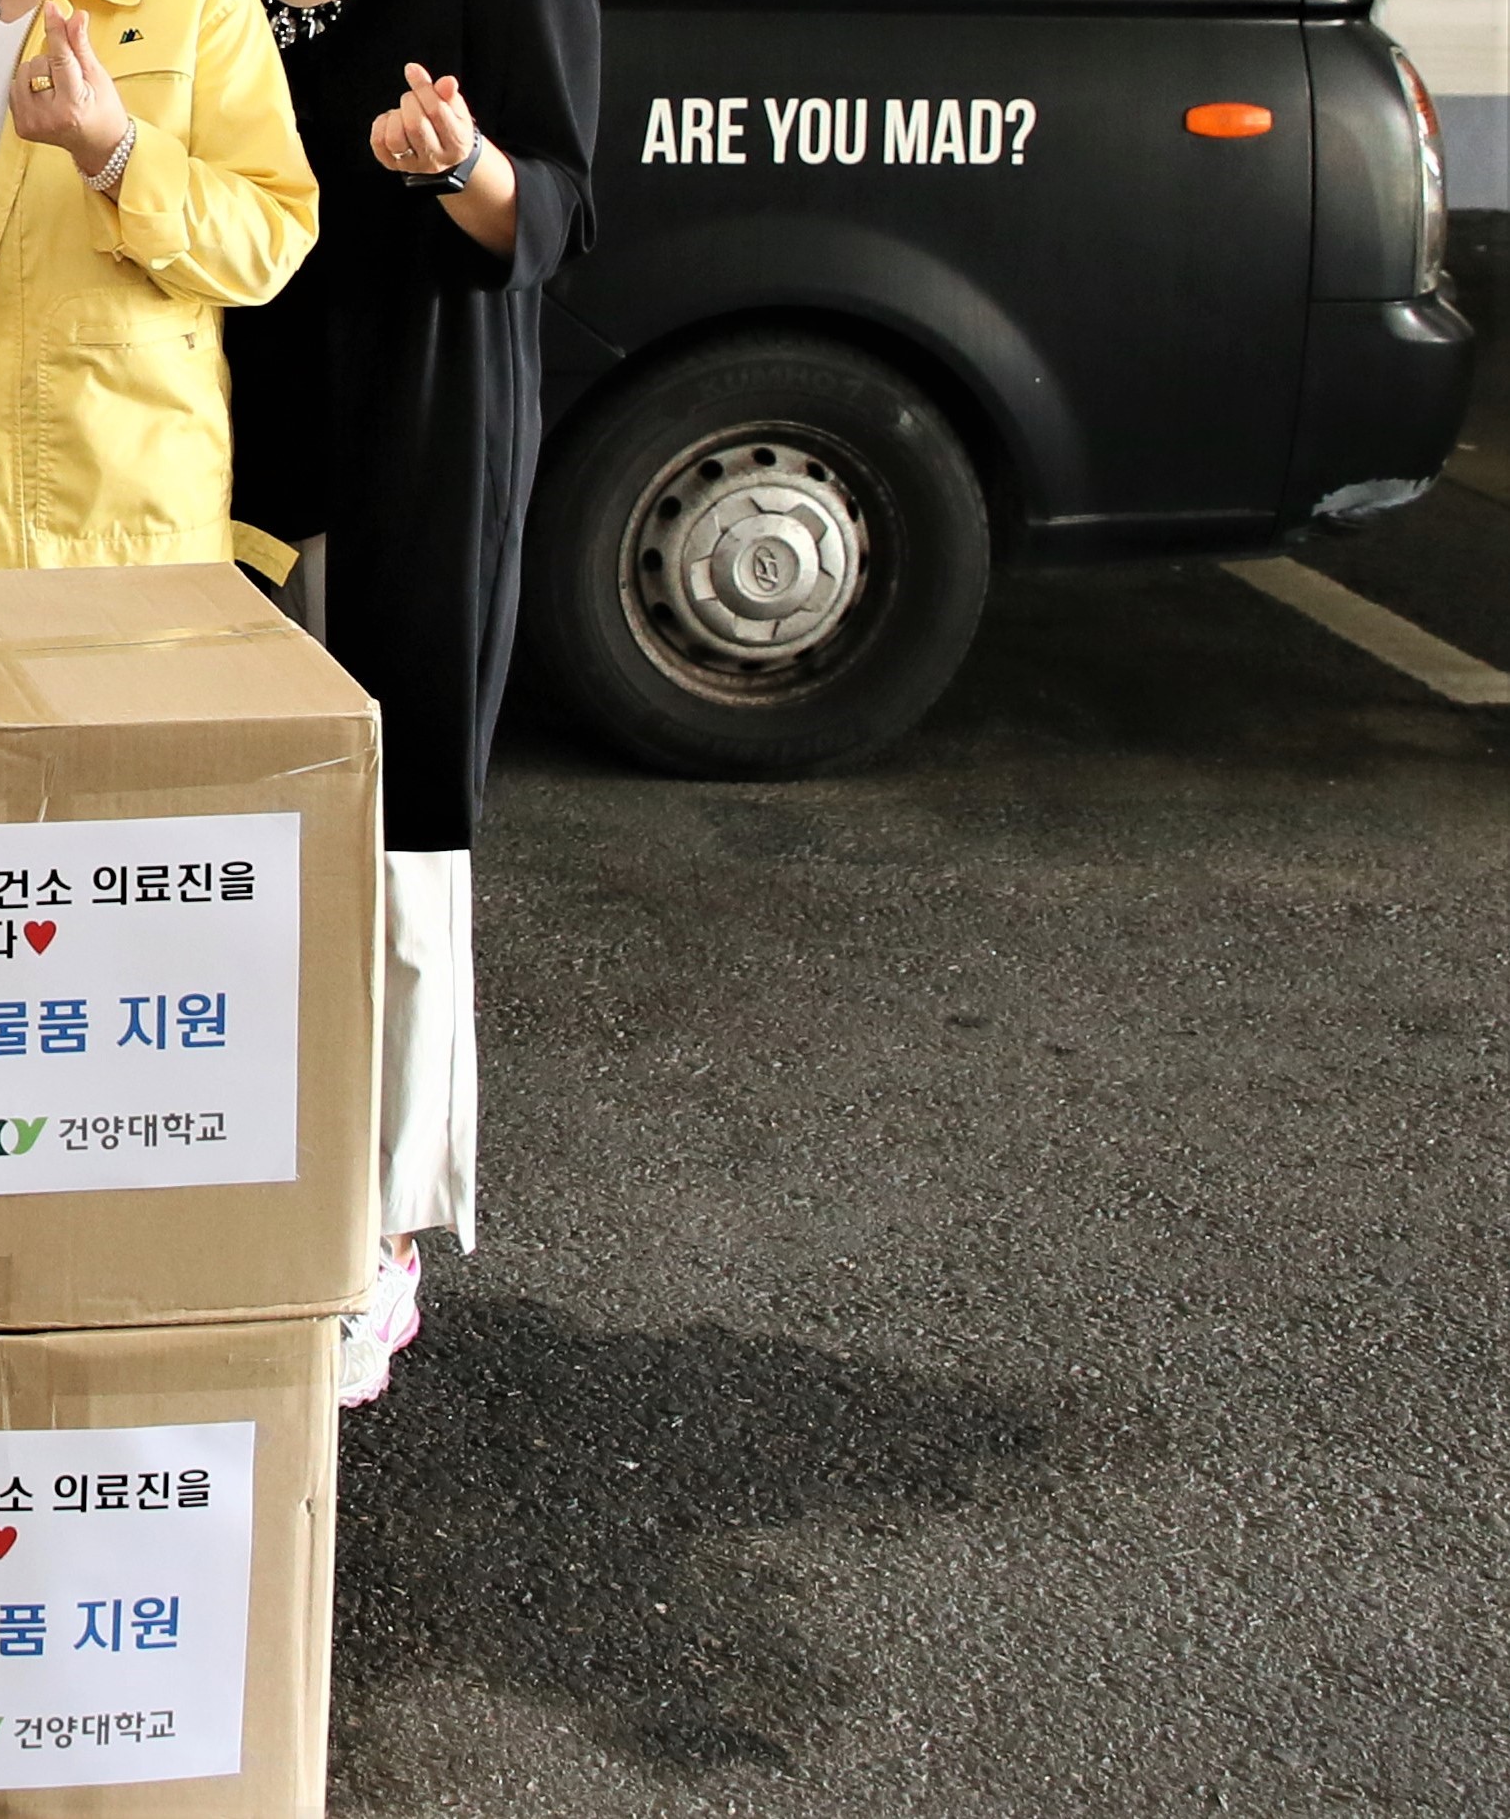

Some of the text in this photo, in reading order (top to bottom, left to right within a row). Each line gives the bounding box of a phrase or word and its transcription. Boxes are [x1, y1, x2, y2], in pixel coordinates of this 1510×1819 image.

[642, 98, 1036, 164] ARE YOU MAD?
[92, 861, 255, 905] 의료진을
[117, 993, 225, 1049] 지원
[59, 1113, 226, 1150] 건양대학교
[53, 1470, 210, 1512] 의료진을
[74, 1596, 179, 1652] 지원
[14, 1711, 175, 1749] 건양대학교
